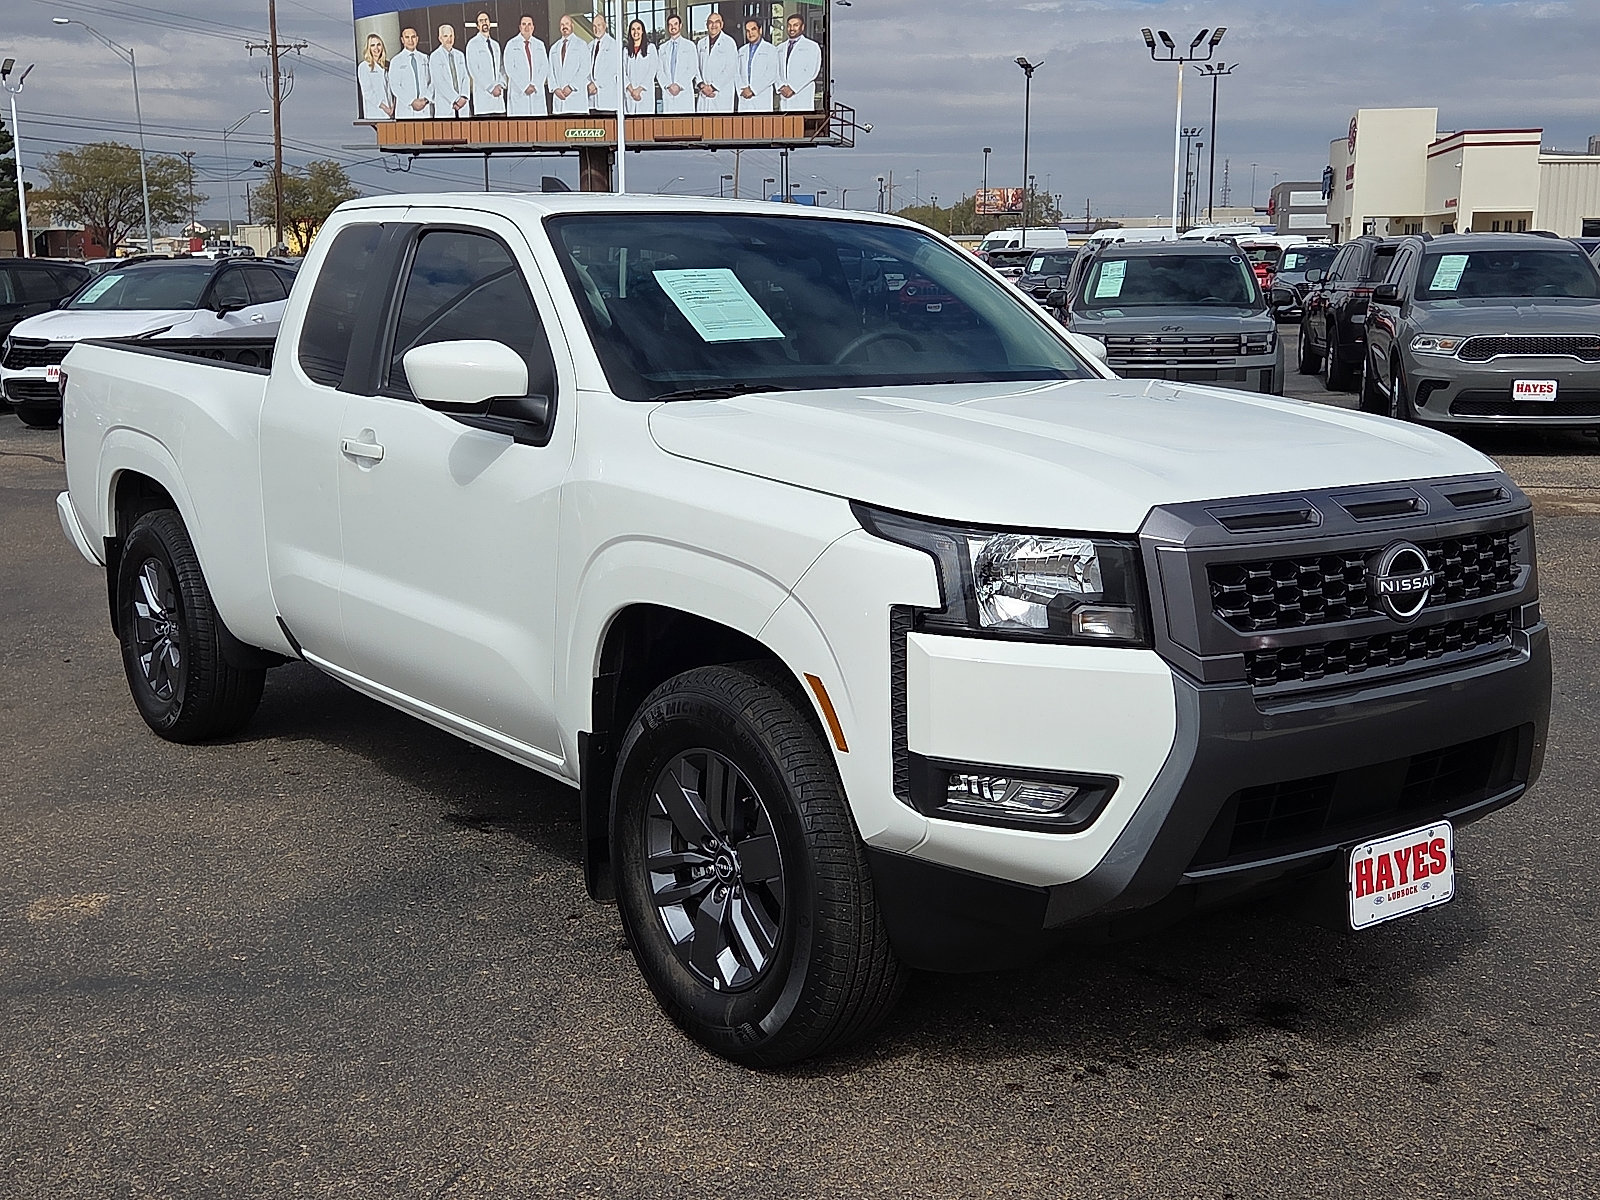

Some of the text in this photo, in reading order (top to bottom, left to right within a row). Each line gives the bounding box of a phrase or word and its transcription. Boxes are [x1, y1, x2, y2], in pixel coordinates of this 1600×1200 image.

[1516, 383, 1554, 393] HAYES
[1380, 574, 1435, 593] NISSAN
[665, 700, 735, 727] MICHEN
[1355, 838, 1447, 899] HAYES
[1387, 884, 1419, 902] LUBBOCK
